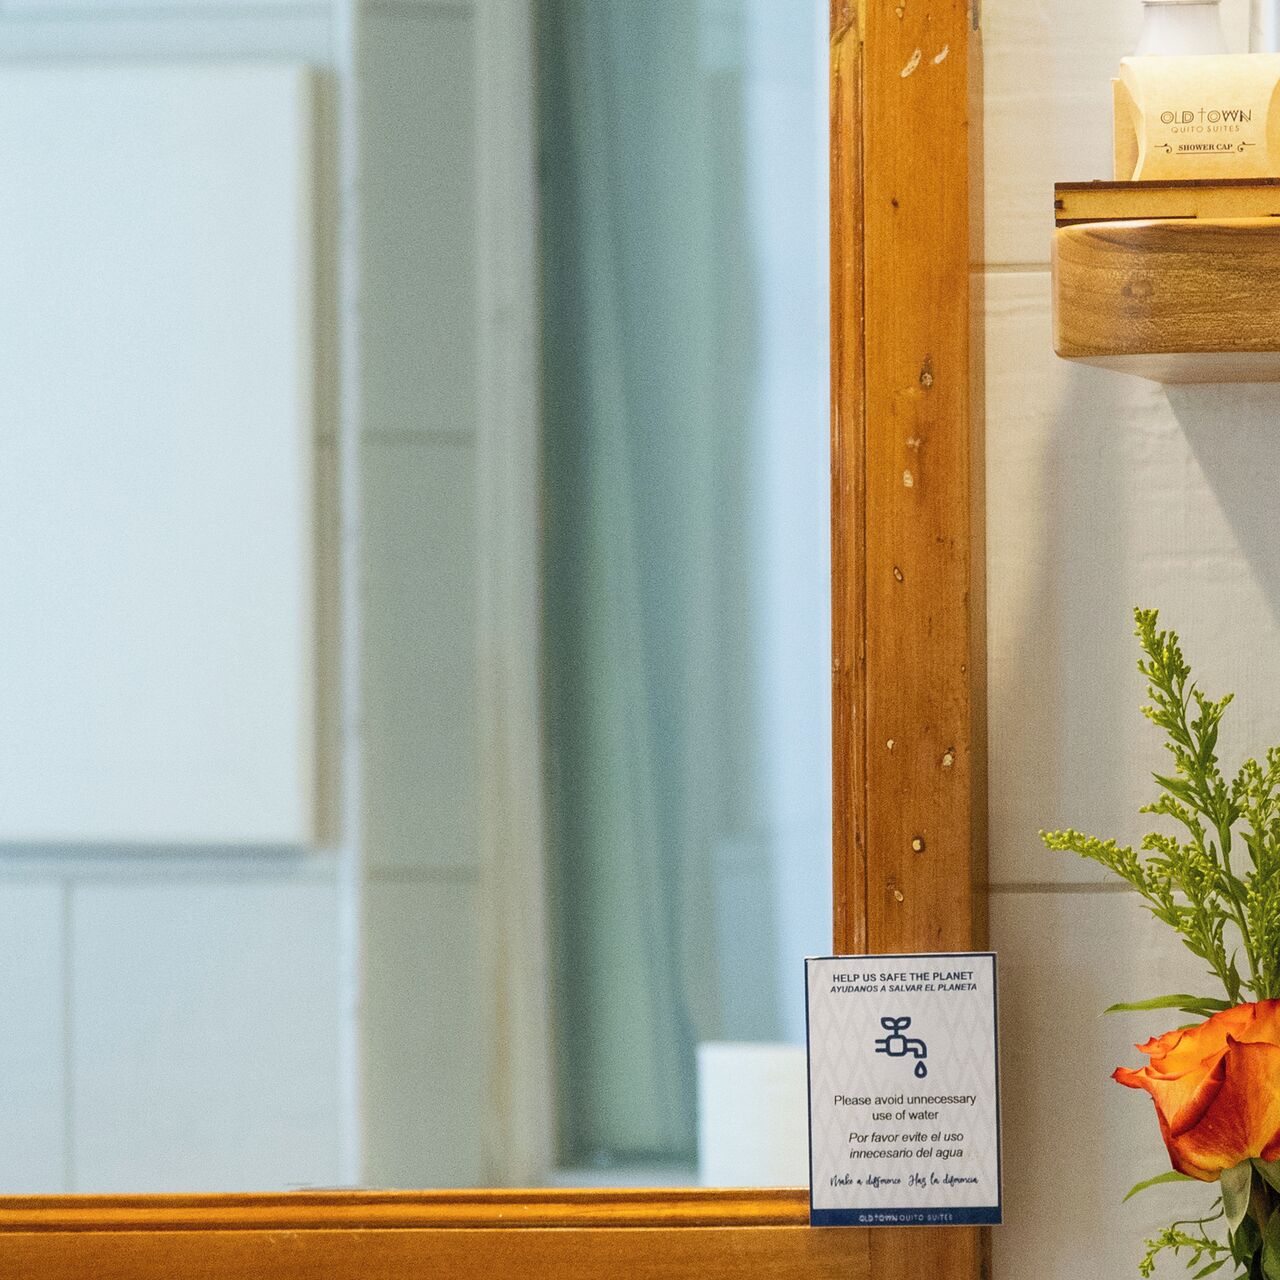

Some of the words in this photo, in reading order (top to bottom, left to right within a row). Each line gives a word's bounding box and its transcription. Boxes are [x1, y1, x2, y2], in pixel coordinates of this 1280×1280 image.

[1160, 110, 1194, 124] OLD
[1171, 126, 1204, 134] QUITO
[1206, 125, 1240, 133] SUITES
[1178, 144, 1215, 152] SHOWER
[1216, 143, 1233, 151] CAP
[833, 974, 860, 982] HELP
[862, 973, 877, 982] US
[879, 973, 907, 982] SAFE
[909, 972, 930, 981] THE
[932, 971, 974, 980] PLANET
[830, 985, 878, 993] AYUDANOS
[888, 984, 922, 992] SALVAR
[924, 984, 935, 992] EL
[937, 983, 978, 991] PLANETA
[834, 1095, 872, 1106] Please
[875, 1094, 904, 1105] avoid
[907, 1095, 976, 1106] unnecessary
[872, 1112, 892, 1120] use
[895, 1110, 906, 1120] of
[908, 1110, 939, 1120] water
[849, 1133, 868, 1143] Por
[871, 1132, 900, 1143] favor
[901, 1132, 928, 1142] evite
[931, 1132, 941, 1141] el
[944, 1133, 964, 1141] uso
[850, 1148, 912, 1158] innecesario
[916, 1148, 933, 1158] del
[936, 1149, 964, 1160] agua
[830, 1173, 853, 1187] Make
[908, 1172, 927, 1188] Haz
[930, 1172, 940, 1185] la
